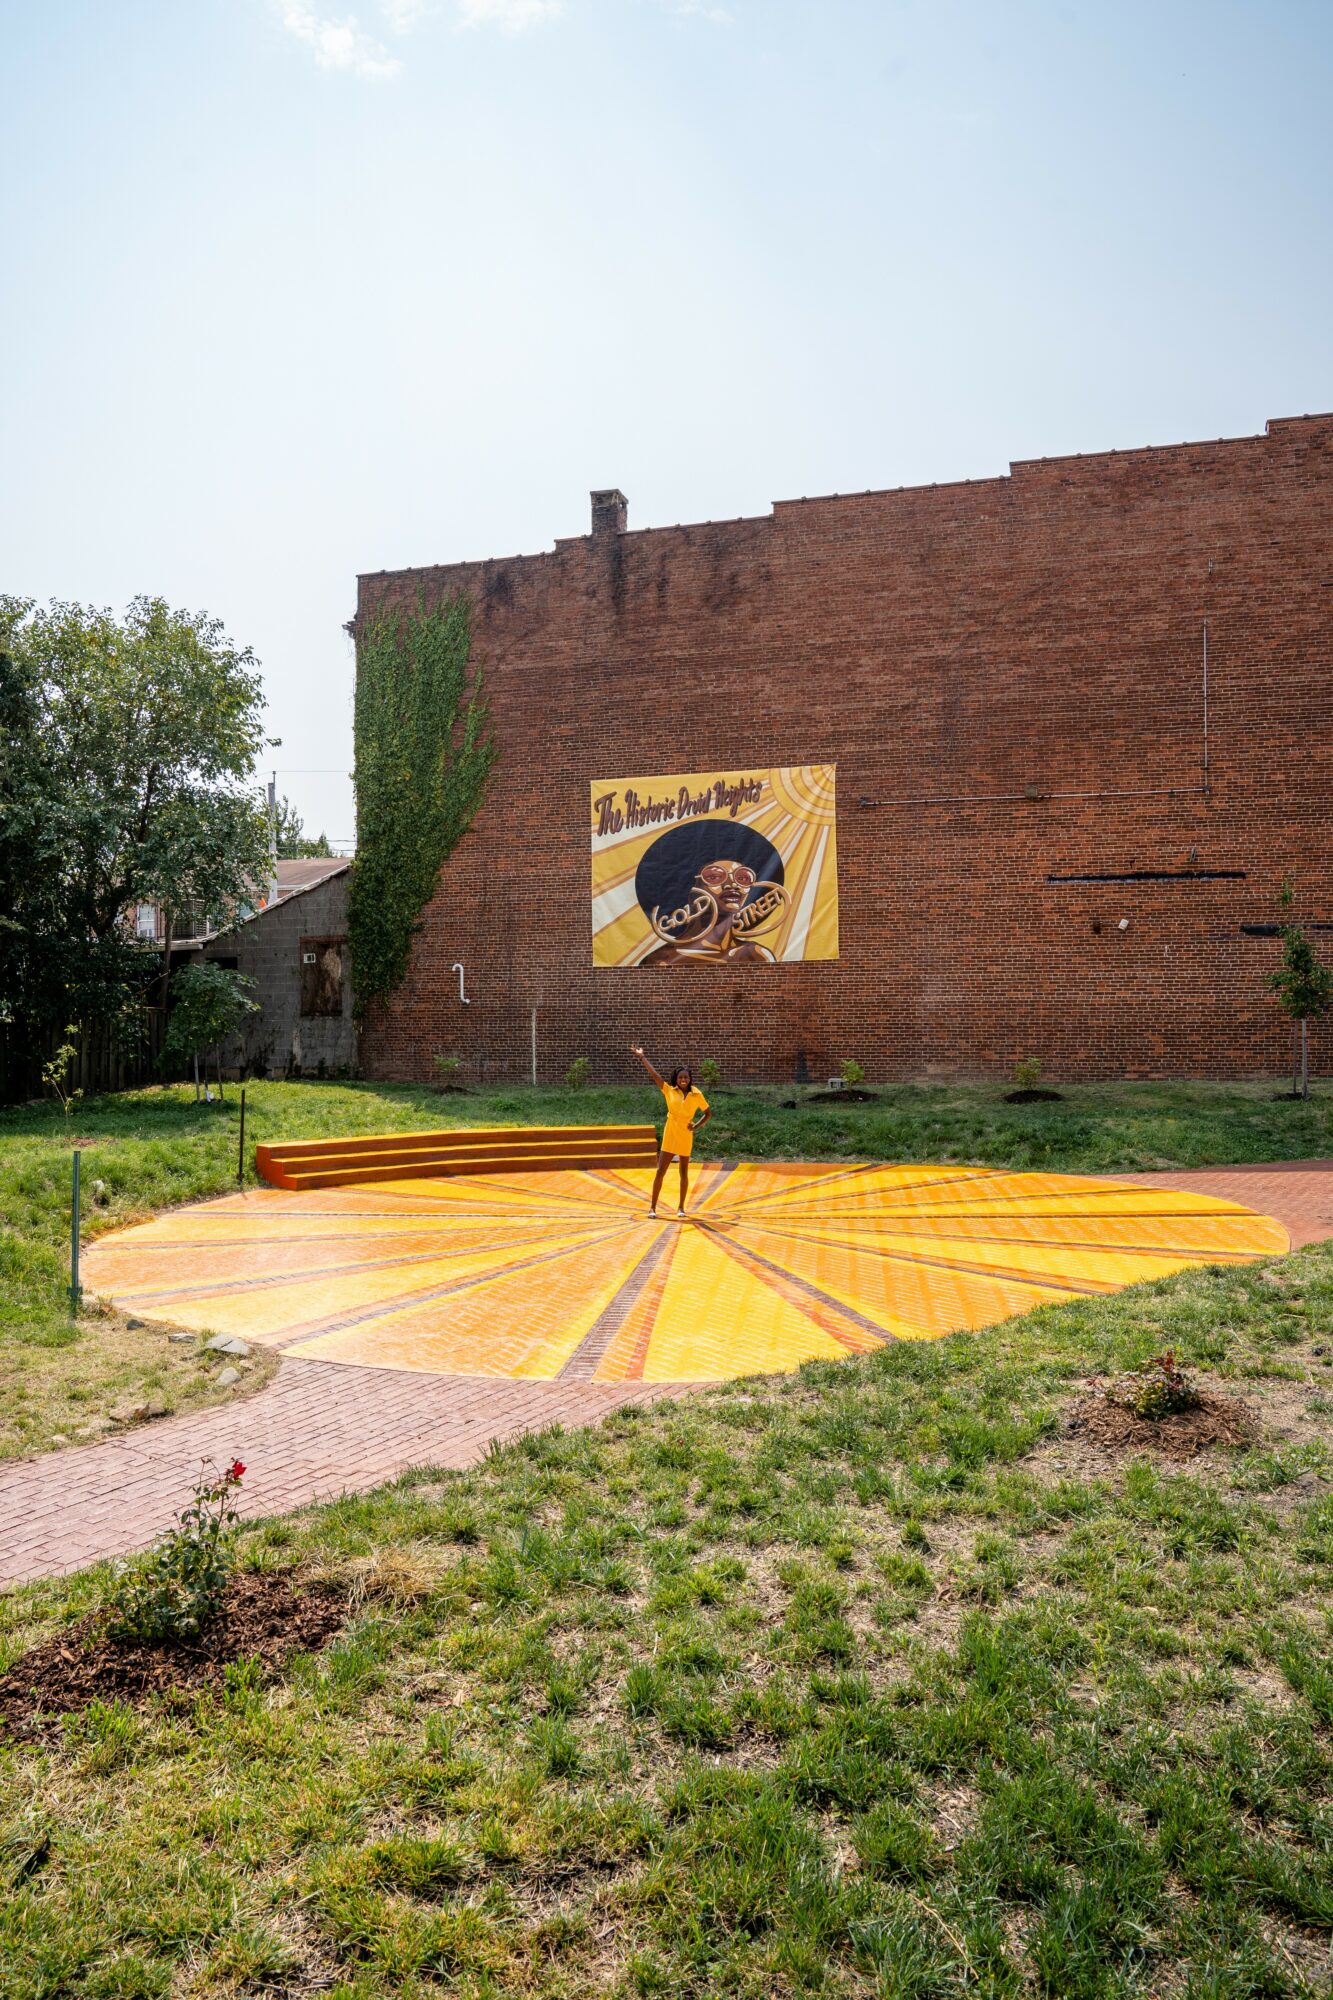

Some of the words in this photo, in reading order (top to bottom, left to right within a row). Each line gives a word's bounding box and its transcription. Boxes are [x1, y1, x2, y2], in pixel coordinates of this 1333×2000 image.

[594, 791, 624, 837] The
[625, 789, 675, 829] Historic
[677, 786, 712, 819] Druid
[713, 778, 762, 817] Heights
[658, 895, 711, 932] GOLD
[732, 888, 784, 931] STREET
